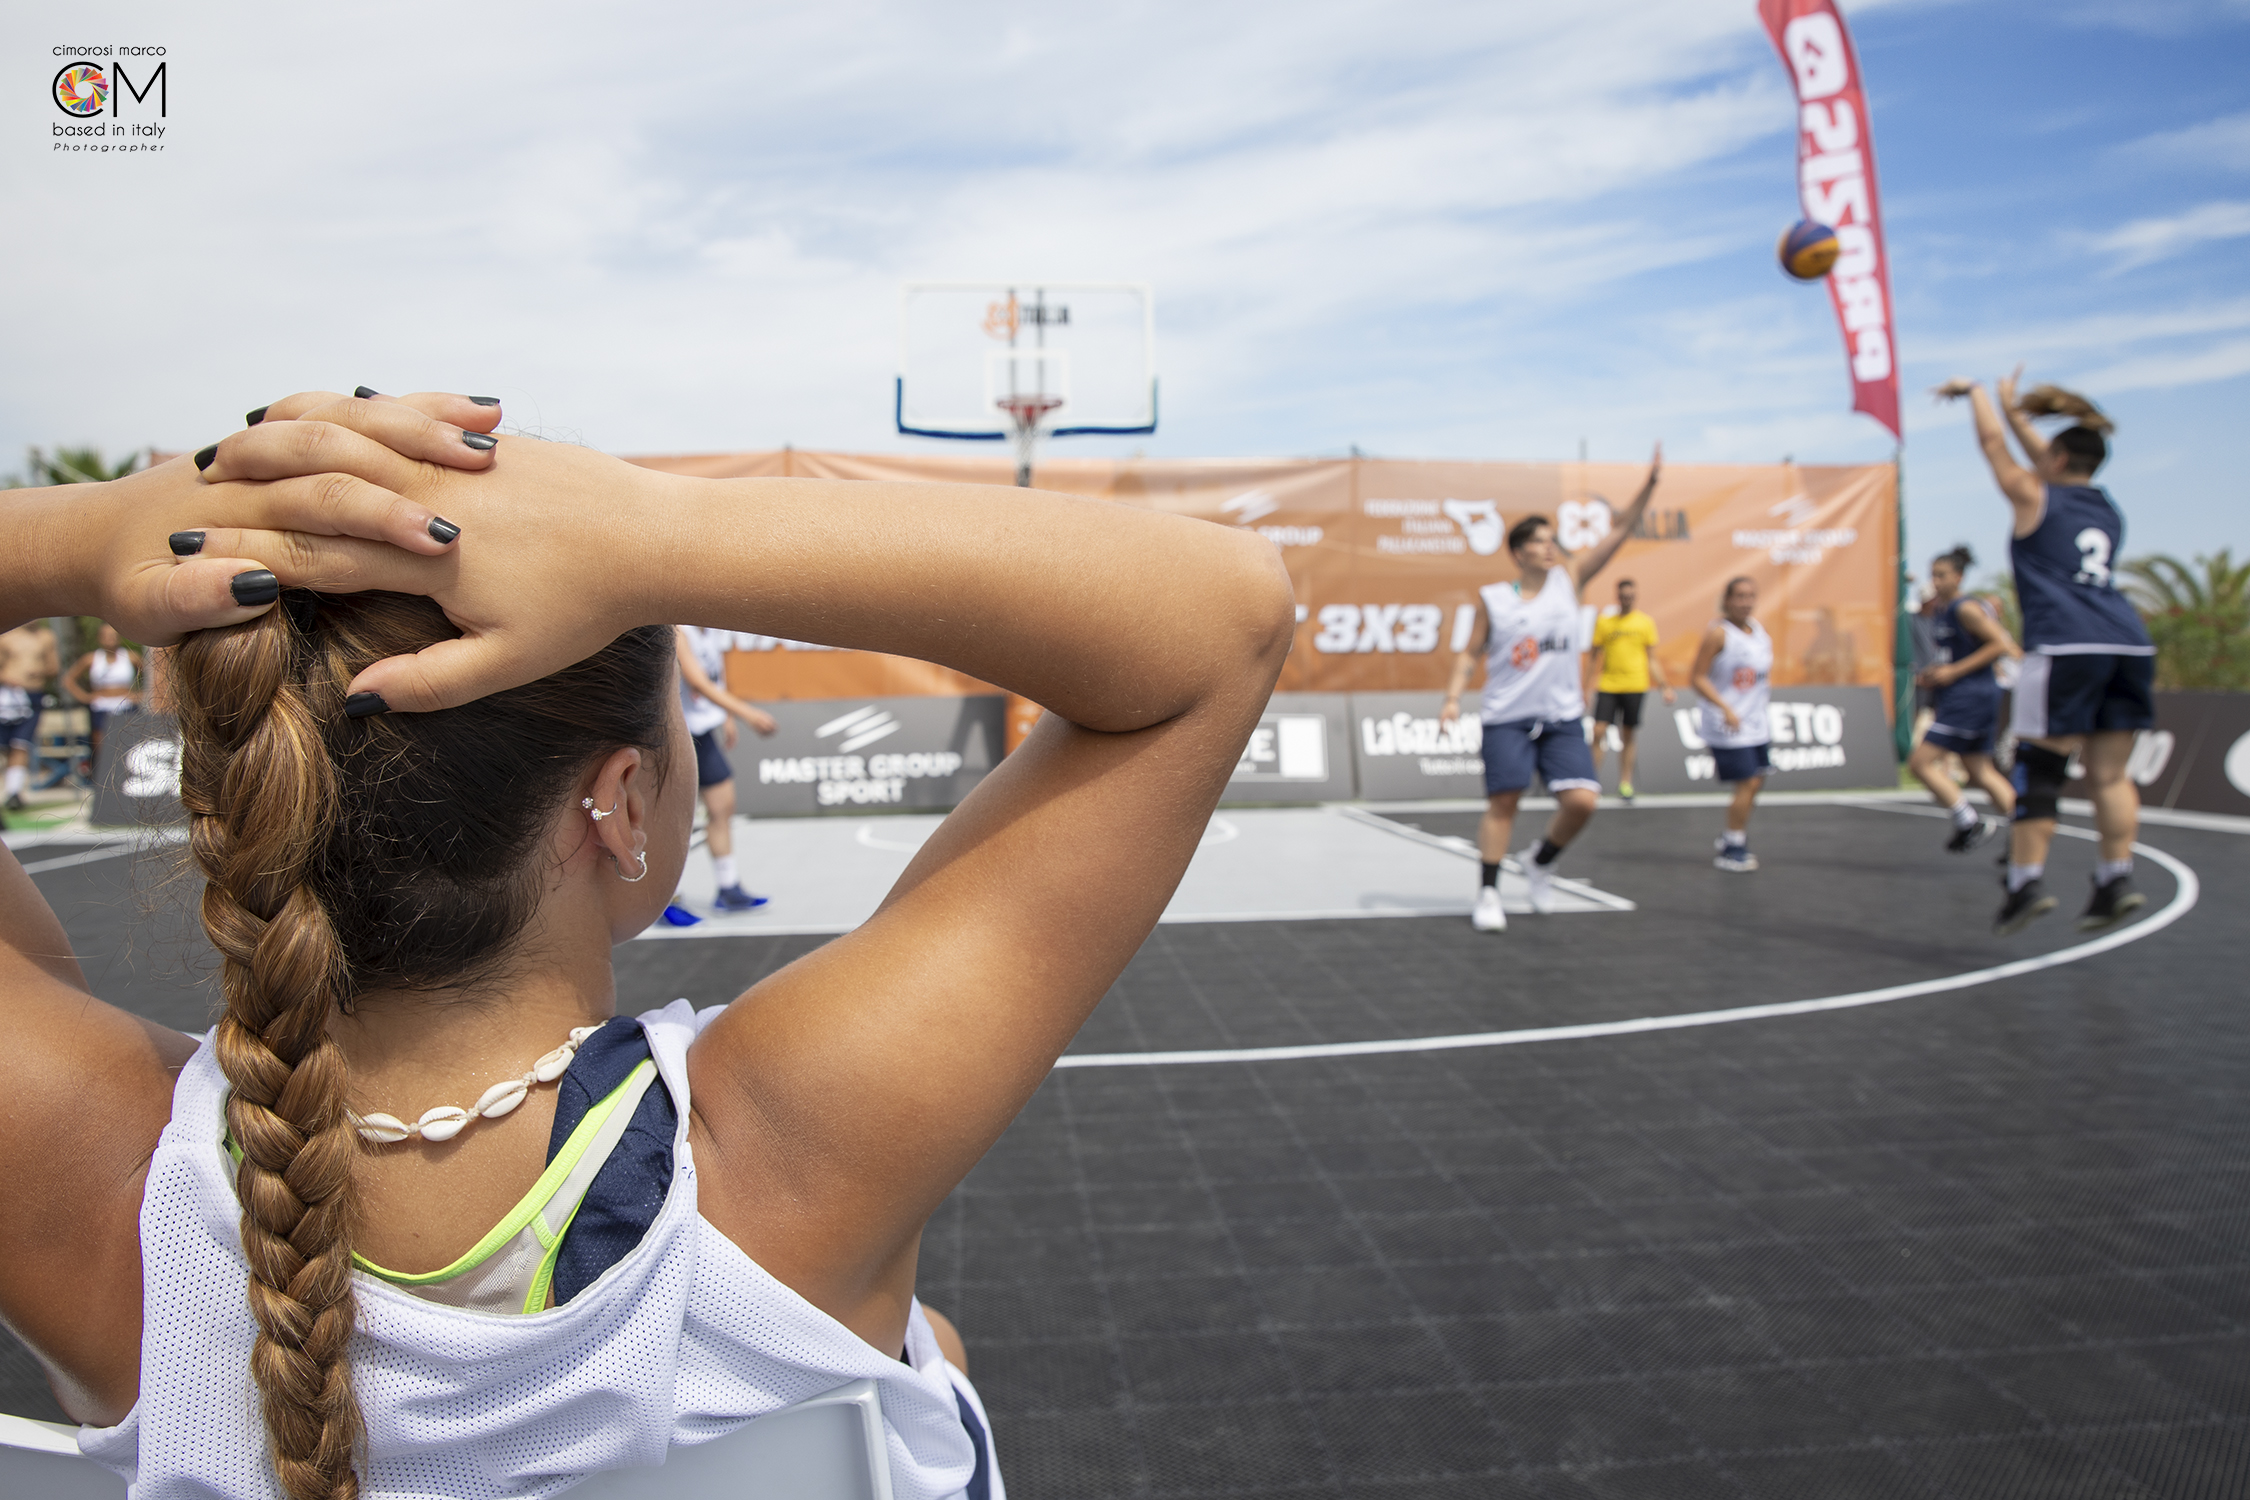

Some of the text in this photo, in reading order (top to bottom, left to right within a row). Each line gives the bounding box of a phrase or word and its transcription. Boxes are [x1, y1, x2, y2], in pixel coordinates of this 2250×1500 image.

[2074, 527, 2112, 587] 3
[1314, 603, 1443, 653] 3X3
[759, 751, 962, 784] MASTER GROUP
[817, 777, 906, 805] SPORT
